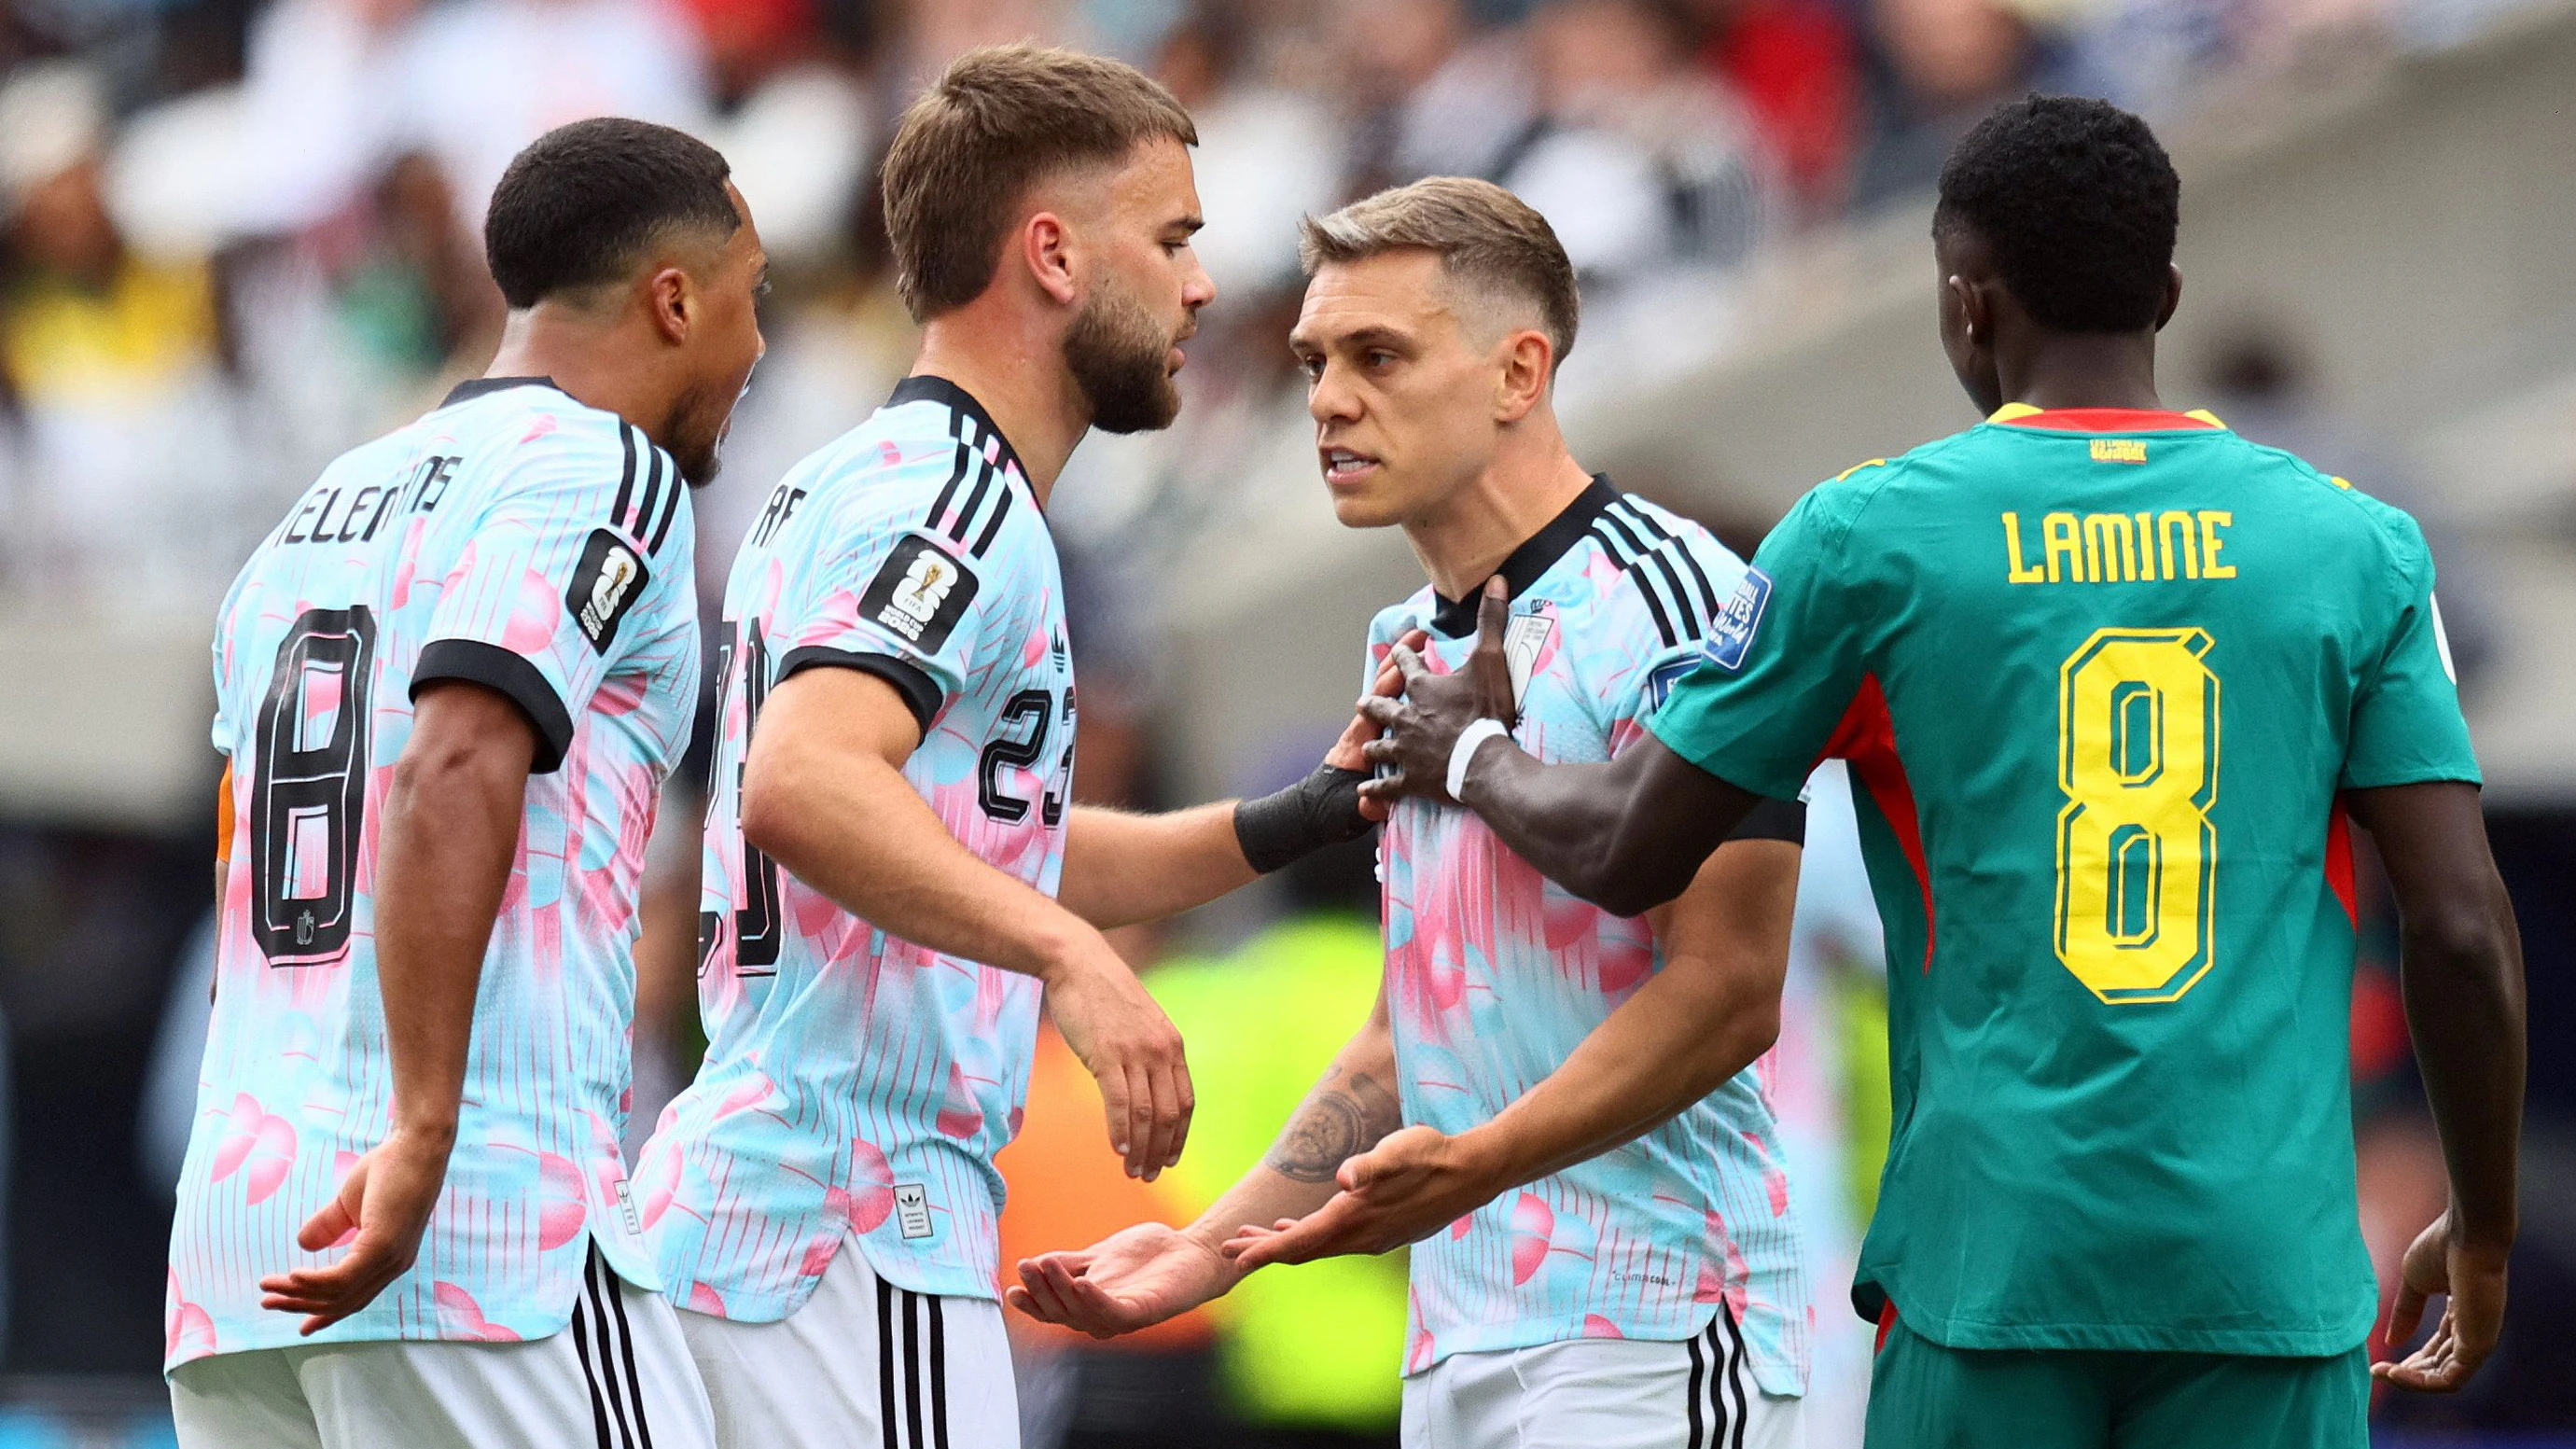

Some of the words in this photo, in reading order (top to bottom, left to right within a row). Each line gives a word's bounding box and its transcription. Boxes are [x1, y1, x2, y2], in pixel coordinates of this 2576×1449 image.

[2001, 510, 2237, 583] LAMINE
[250, 605, 378, 968] 8
[2054, 627, 2221, 1005] 8
